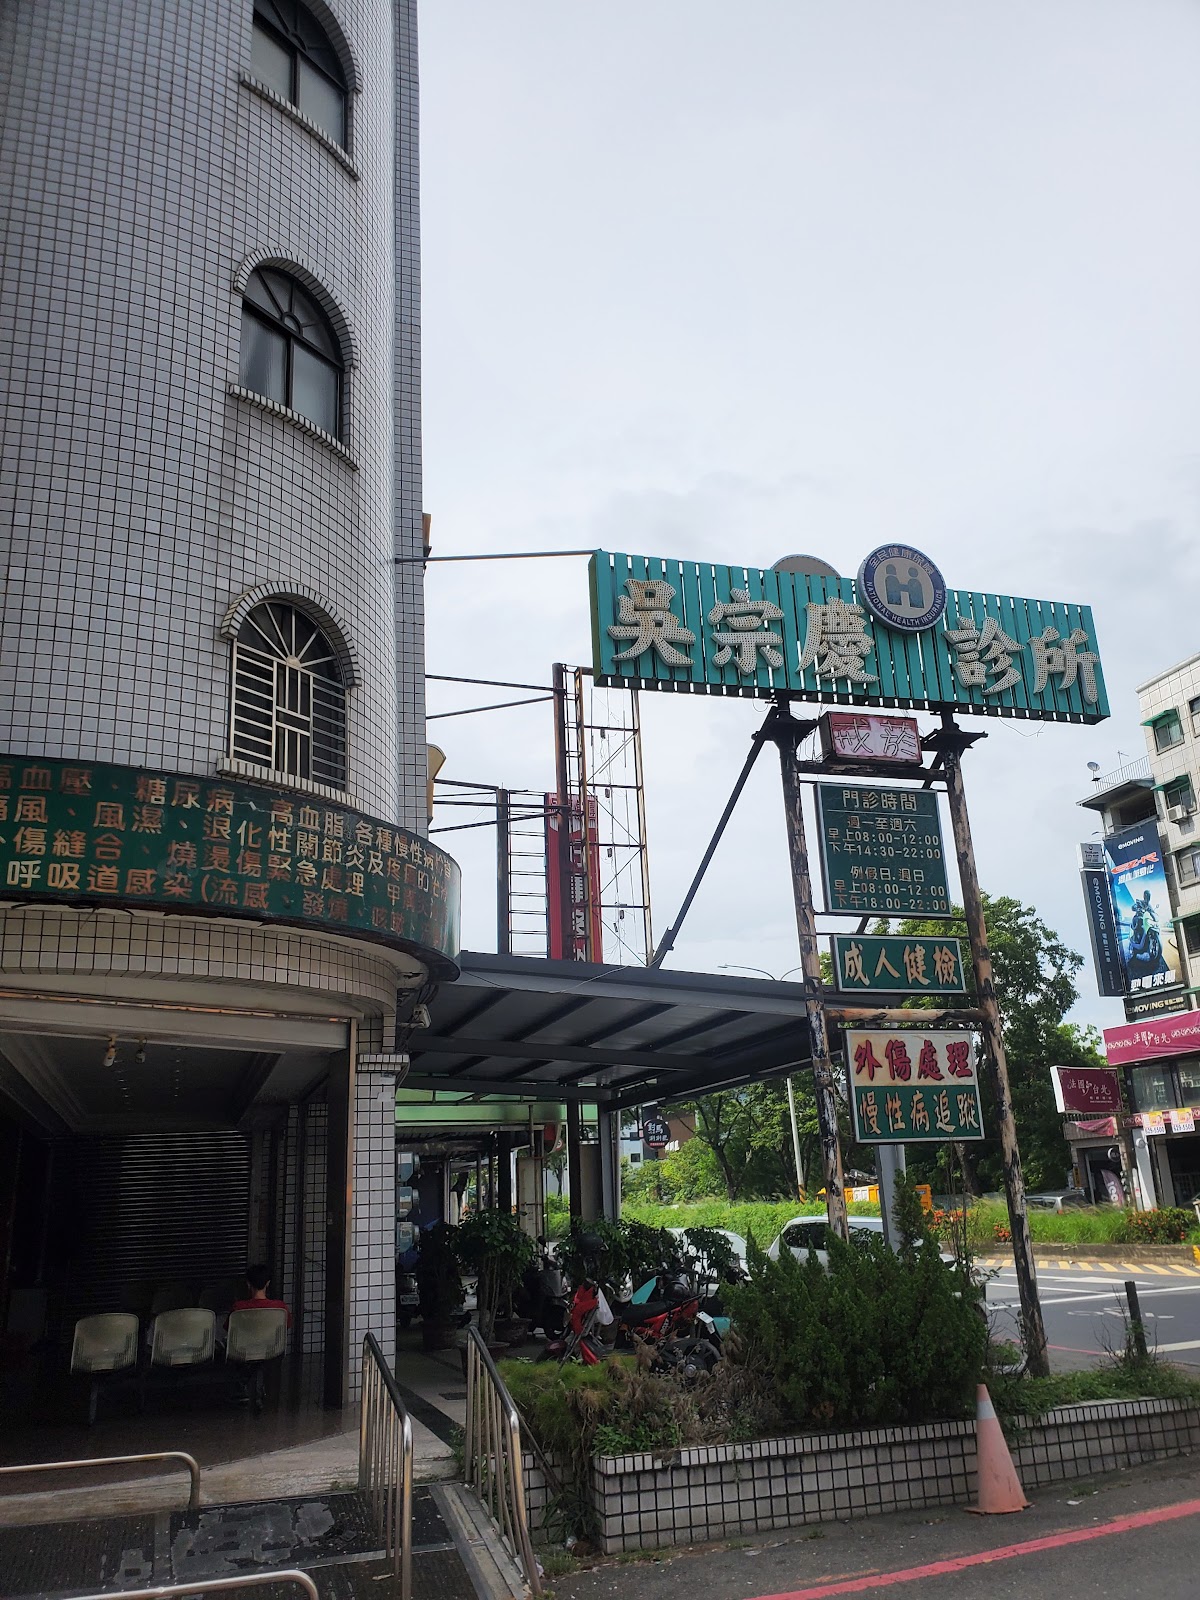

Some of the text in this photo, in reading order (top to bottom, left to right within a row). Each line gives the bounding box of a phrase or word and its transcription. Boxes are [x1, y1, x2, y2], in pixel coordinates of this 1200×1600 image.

[866, 580, 943, 626] NATIONAL HEALTH INSURANCE
[943, 616, 1100, 704] 診所
[833, 718, 917, 757] 戒菸
[842, 789, 917, 811] 門診時間
[847, 815, 917, 832] 週一至週六
[844, 940, 959, 986] 成人健檢
[1126, 999, 1165, 1015] eMOVING
[854, 1039, 973, 1081] 外傷處理
[859, 1089, 980, 1135] 慢性病追蹤
